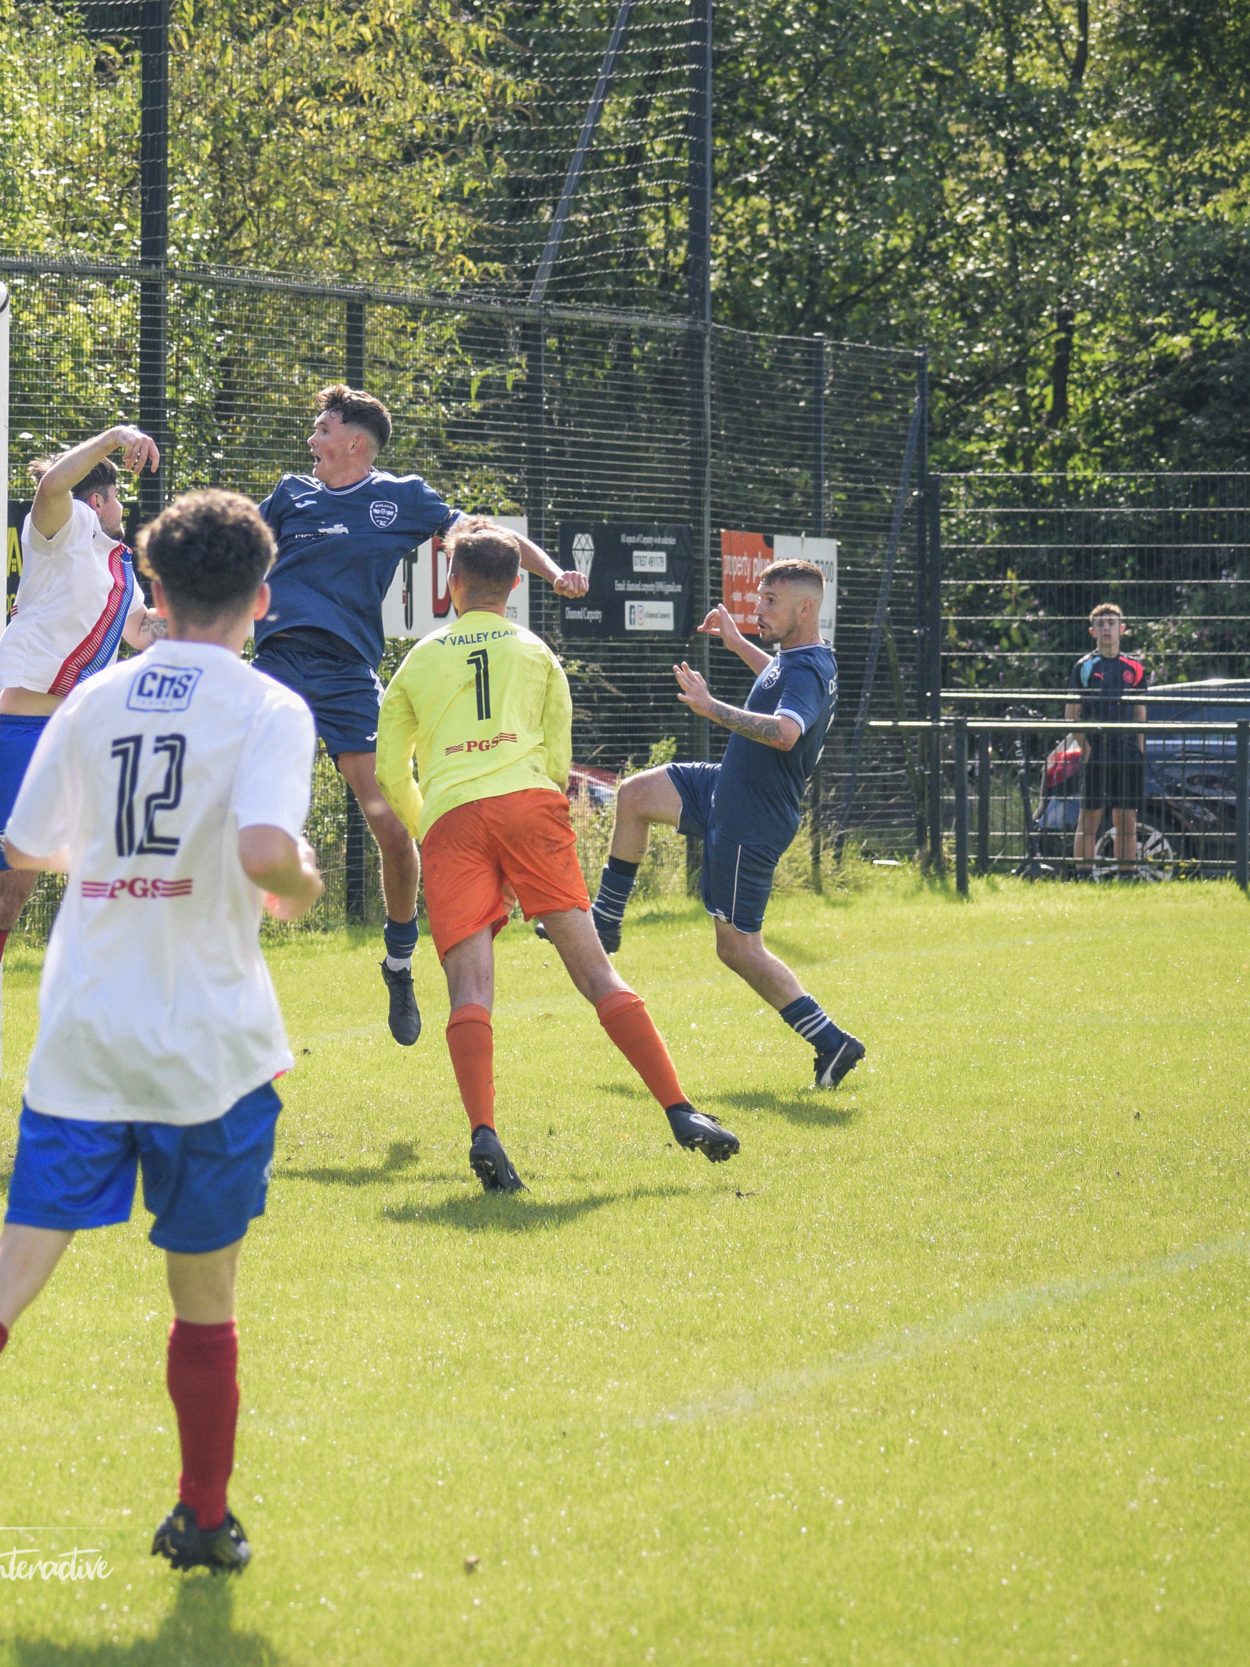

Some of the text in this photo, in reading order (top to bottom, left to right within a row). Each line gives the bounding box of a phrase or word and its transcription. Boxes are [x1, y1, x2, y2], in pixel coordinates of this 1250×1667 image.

[450, 632, 489, 646] VALLEY
[137, 671, 193, 698] CMS
[467, 648, 491, 721] 1
[466, 737, 500, 753] PGS
[111, 733, 186, 857] 12
[107, 877, 163, 899] PGS
